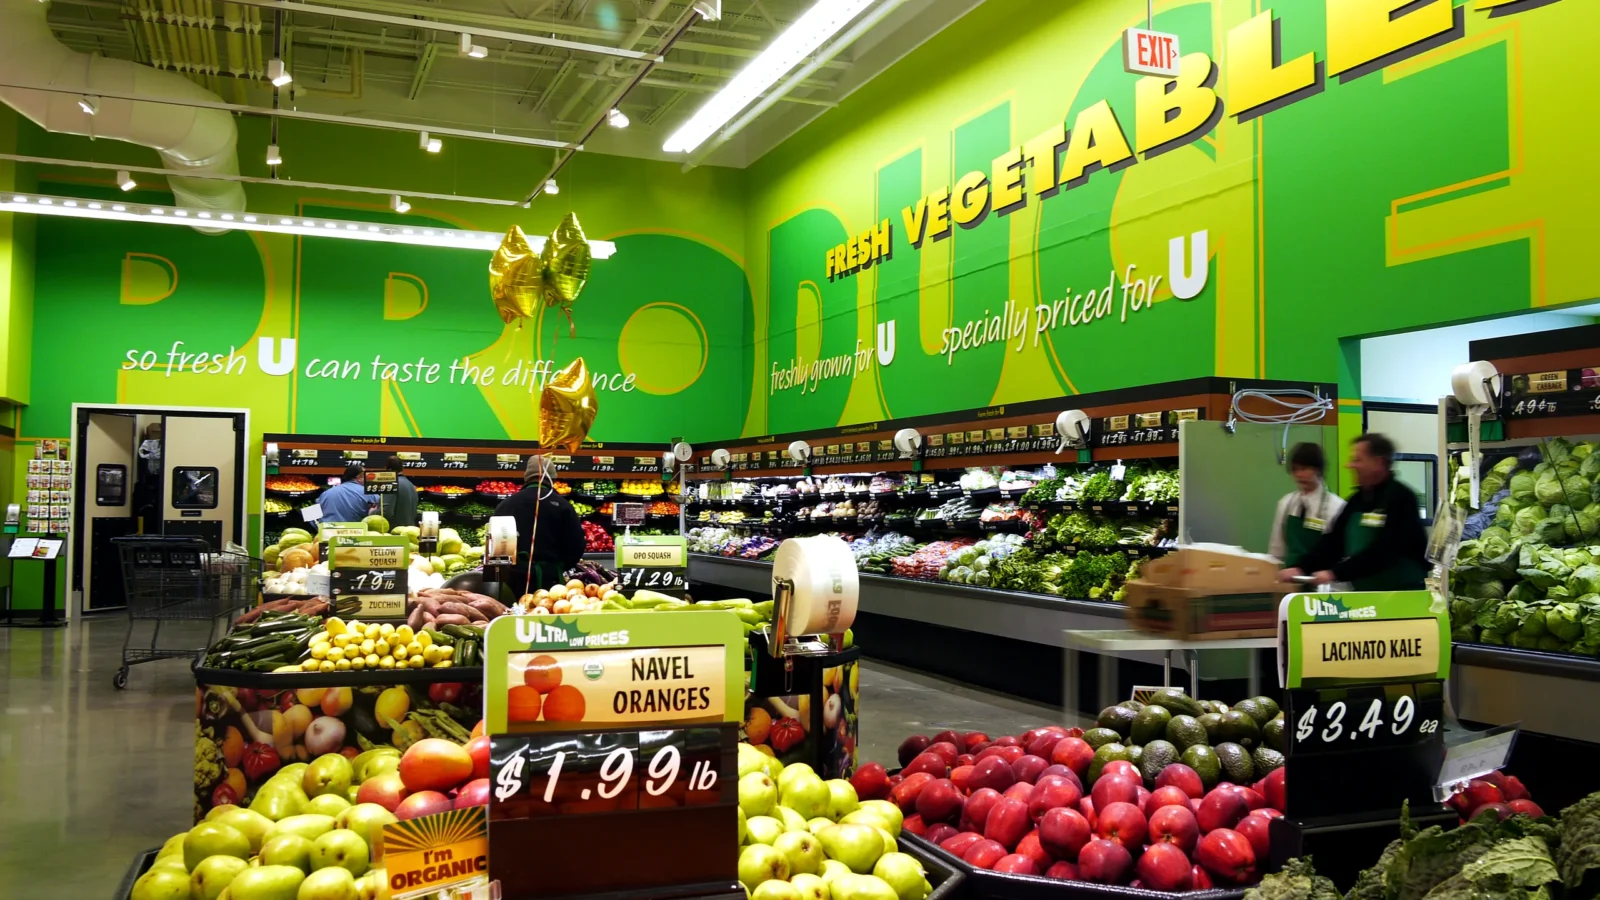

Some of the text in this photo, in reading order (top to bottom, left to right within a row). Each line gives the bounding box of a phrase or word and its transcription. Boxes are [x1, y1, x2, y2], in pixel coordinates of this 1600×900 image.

[1137, 33, 1172, 69] EXIT
[826, 0, 1560, 281] FRESH VEGETABLE
[940, 229, 1209, 366] specially priced for U
[122, 350, 157, 370] so
[165, 341, 247, 377] fresh
[258, 336, 296, 375] U
[305, 358, 361, 380] can
[371, 355, 440, 384] taste
[449, 356, 495, 386] the
[771, 320, 896, 396] freshly grown for U
[1536, 382, 1563, 390] CABBAGE
[370, 548, 396, 556] YELLOW
[370, 558, 396, 566] SQUASH
[634, 552, 672, 560] OPO SQUASH
[384, 580, 394, 590] lb
[674, 577, 683, 586] lb
[369, 601, 401, 609] ZUCCHINI
[1304, 596, 1338, 616] ULTRA
[1349, 605, 1376, 618] PRICES
[516, 618, 630, 646] ULTRA LOW PRICES
[1322, 638, 1422, 662] LACINATO KALE
[632, 656, 694, 682] NAVEL
[613, 686, 710, 714] ORANGES
[1296, 695, 1438, 743] $3.49 ea
[495, 745, 717, 802] $1.99 lb
[424, 848, 452, 865] I'm
[390, 856, 487, 890] ORGANIC
